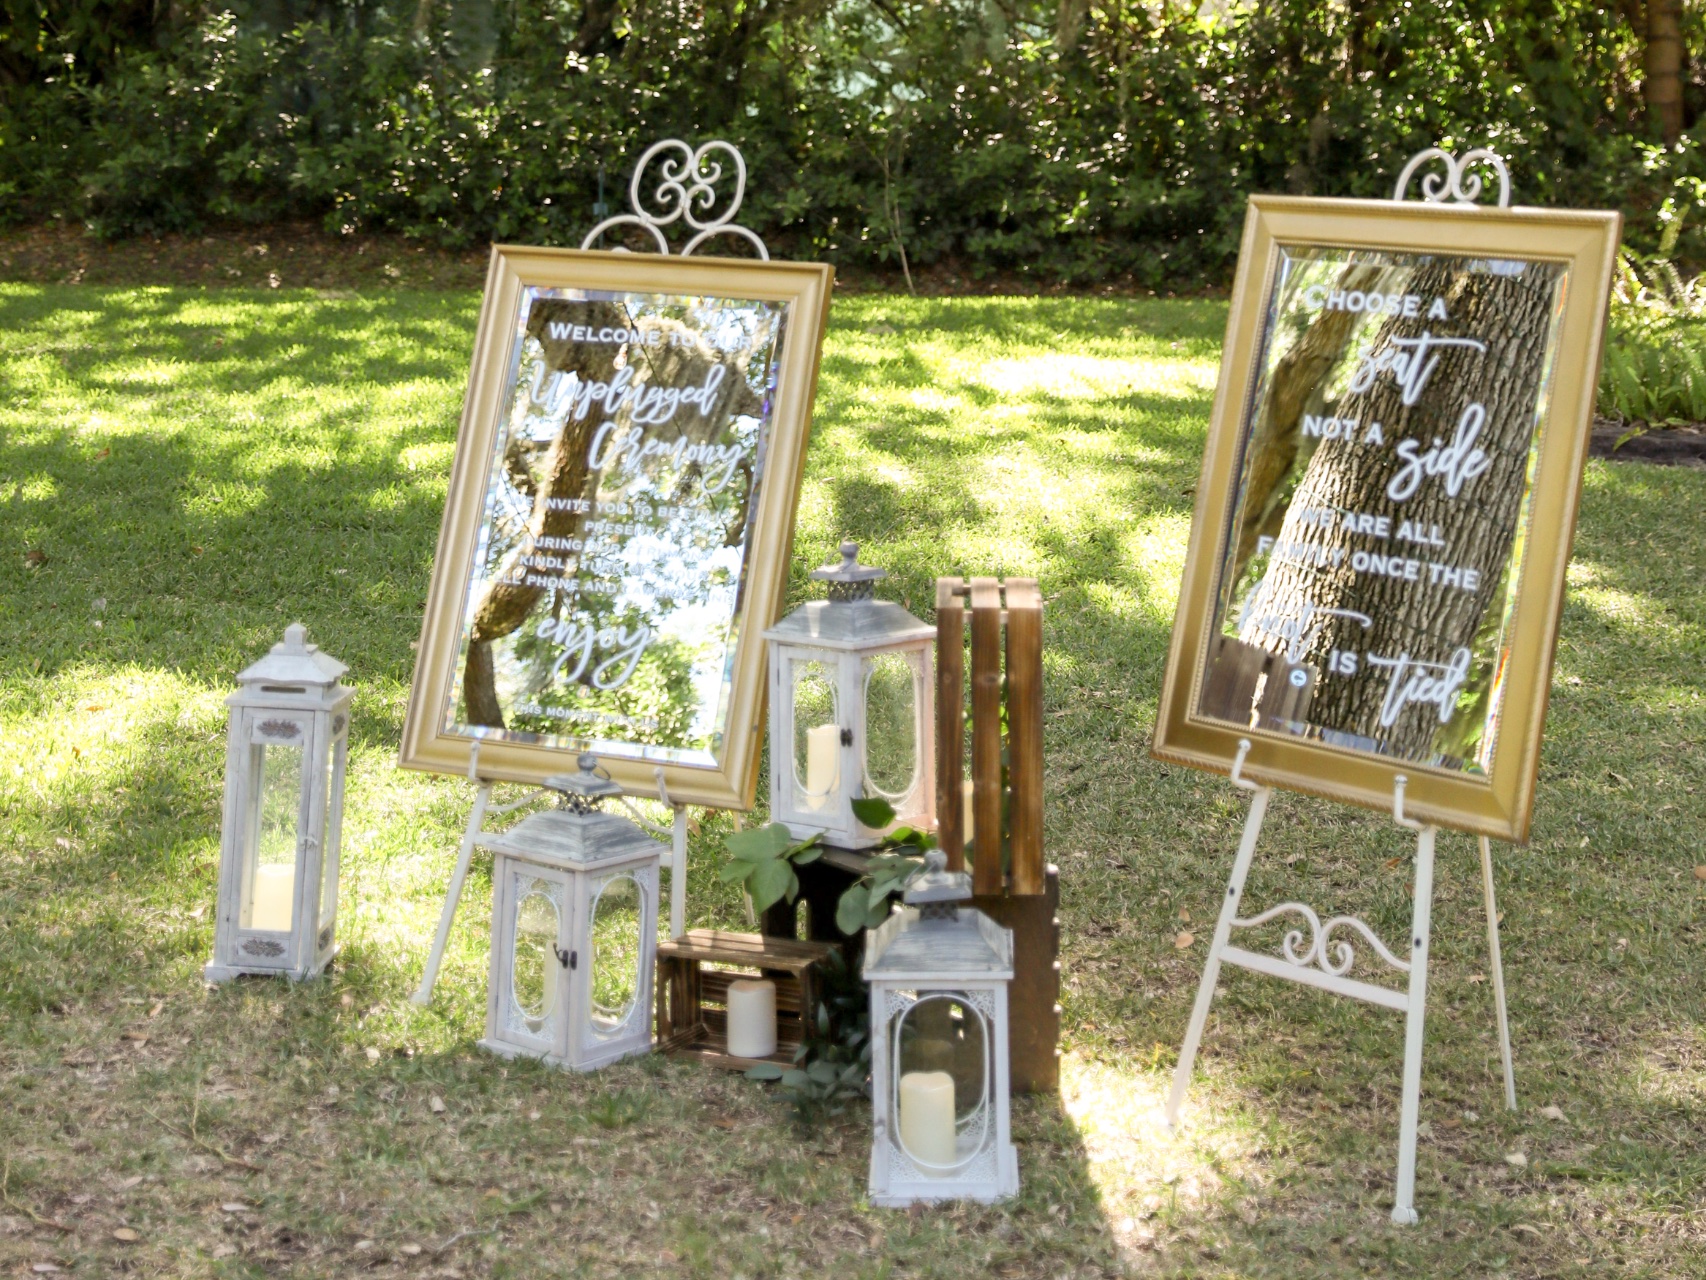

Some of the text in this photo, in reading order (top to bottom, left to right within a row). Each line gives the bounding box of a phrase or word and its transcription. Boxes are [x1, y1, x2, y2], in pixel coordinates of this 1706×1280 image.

[1305, 284, 1447, 319] CHOOSE A
[550, 322, 659, 345] WELCOME
[670, 332, 696, 347] TO
[1350, 331, 1486, 406] seat
[531, 360, 726, 423] Unplugged
[588, 421, 750, 494] Ceremony
[1302, 403, 1490, 501] NOT A side
[540, 497, 591, 512] INVITE
[596, 502, 627, 515] YOU
[633, 505, 653, 516] TO
[1300, 507, 1446, 546] WE ARE ALL
[526, 574, 580, 592] PHONE
[1352, 551, 1420, 581] ONCE
[1428, 563, 1481, 591] THE
[537, 617, 657, 689] enjoy
[1328, 649, 1358, 674] IS
